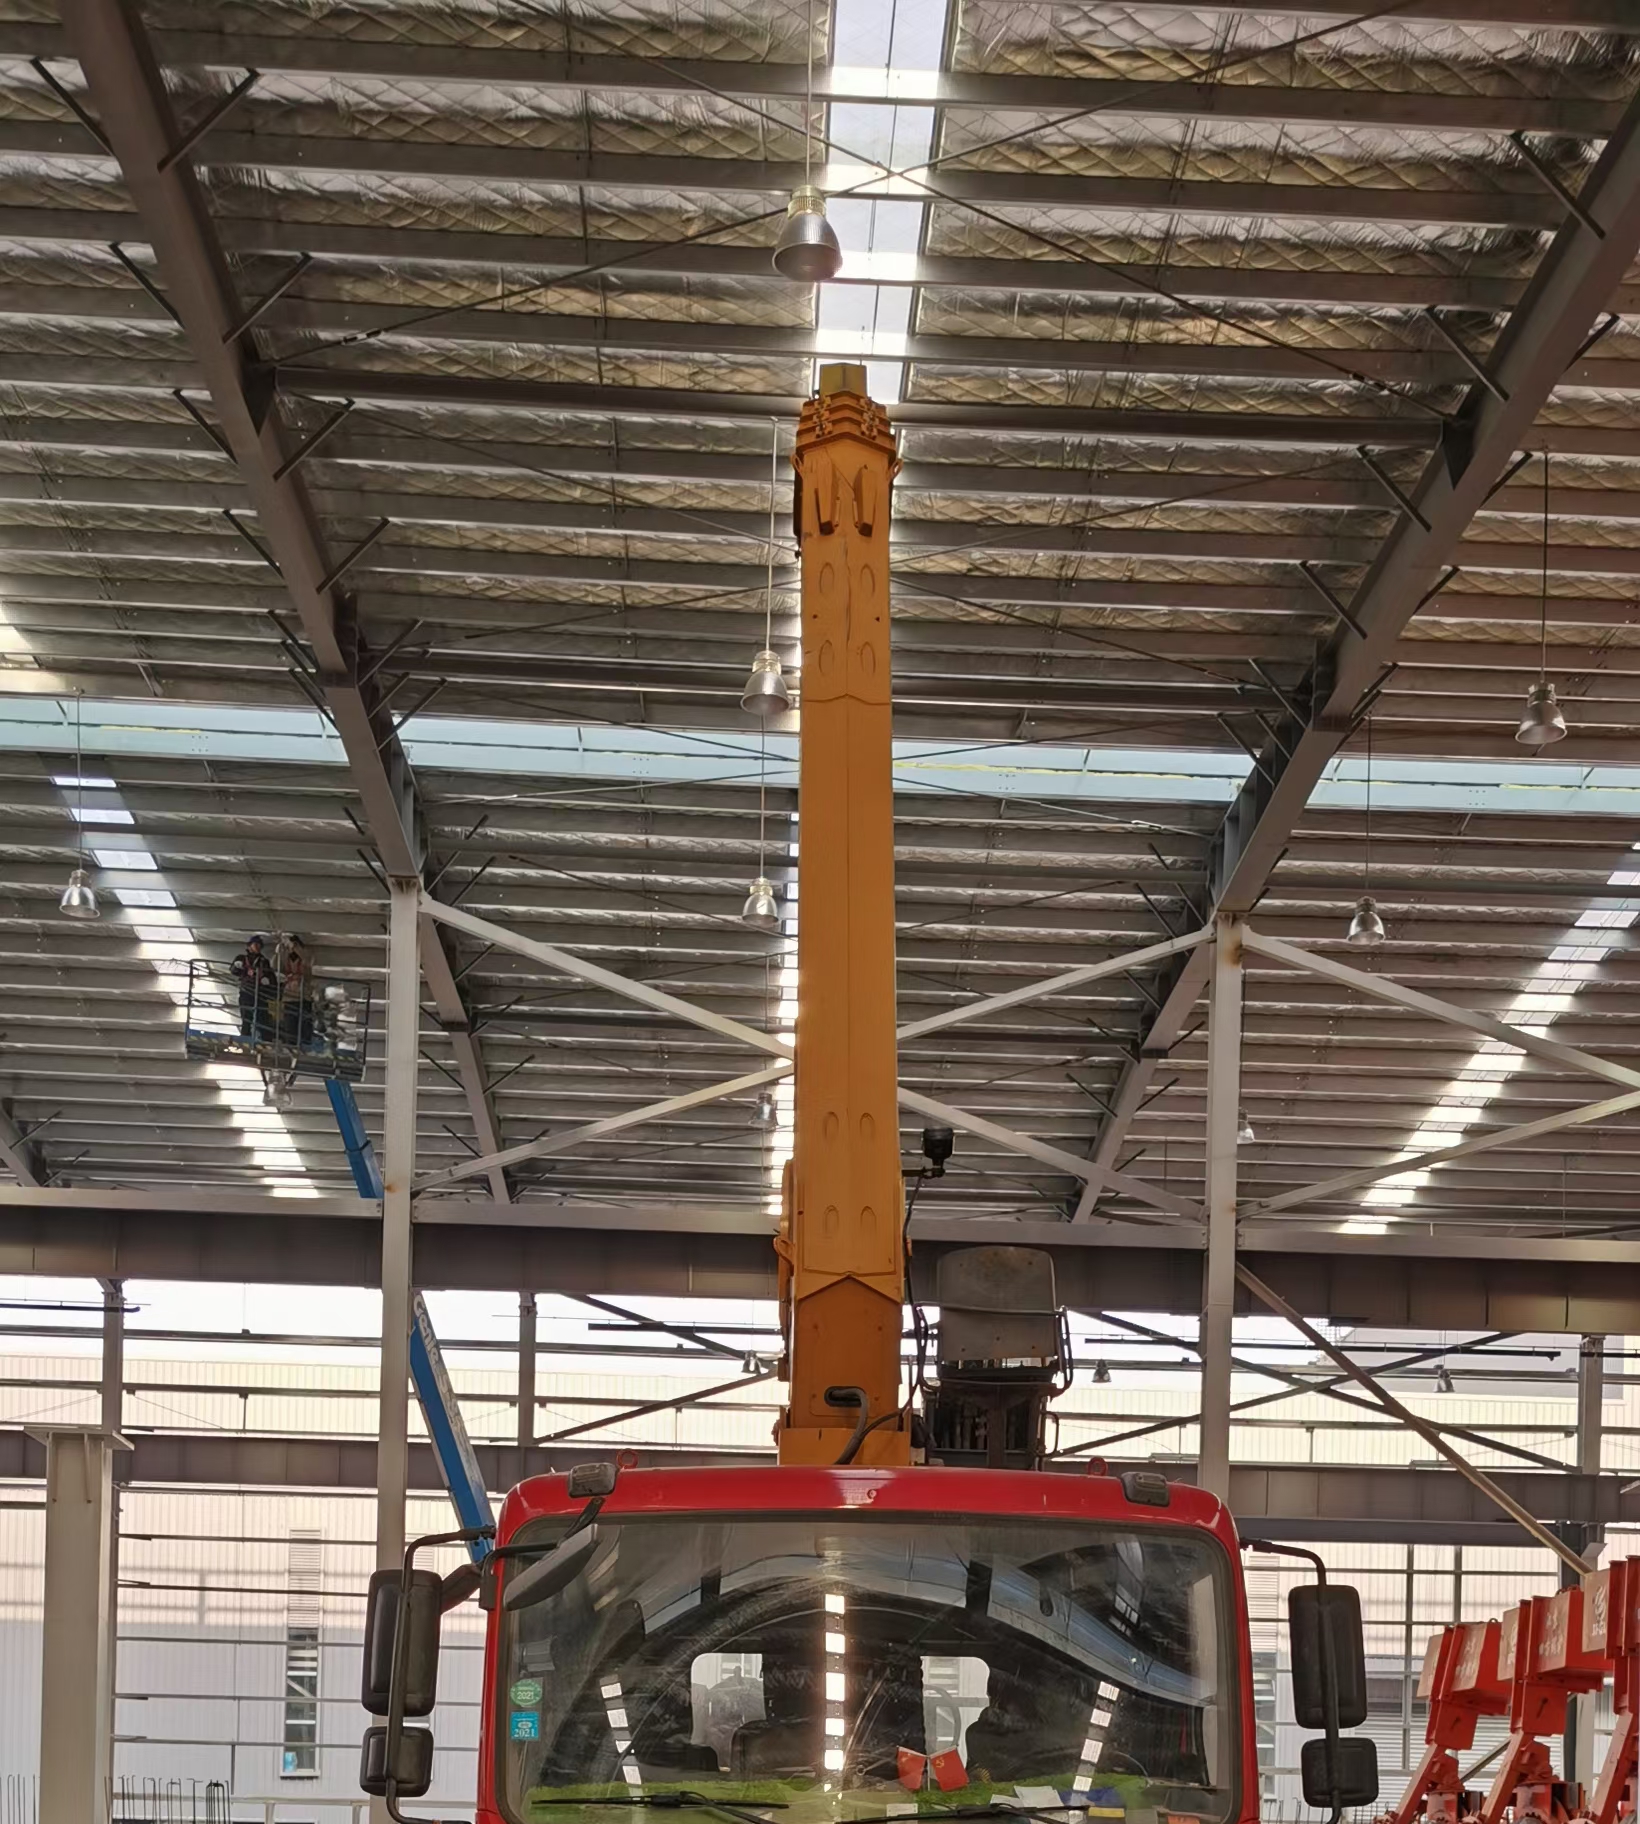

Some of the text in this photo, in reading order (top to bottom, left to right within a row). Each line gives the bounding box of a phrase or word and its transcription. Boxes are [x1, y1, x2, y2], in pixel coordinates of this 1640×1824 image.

[413, 1294, 440, 1366] Genie
[516, 1691, 534, 1700] 2021
[513, 1728, 535, 1738] 2021
